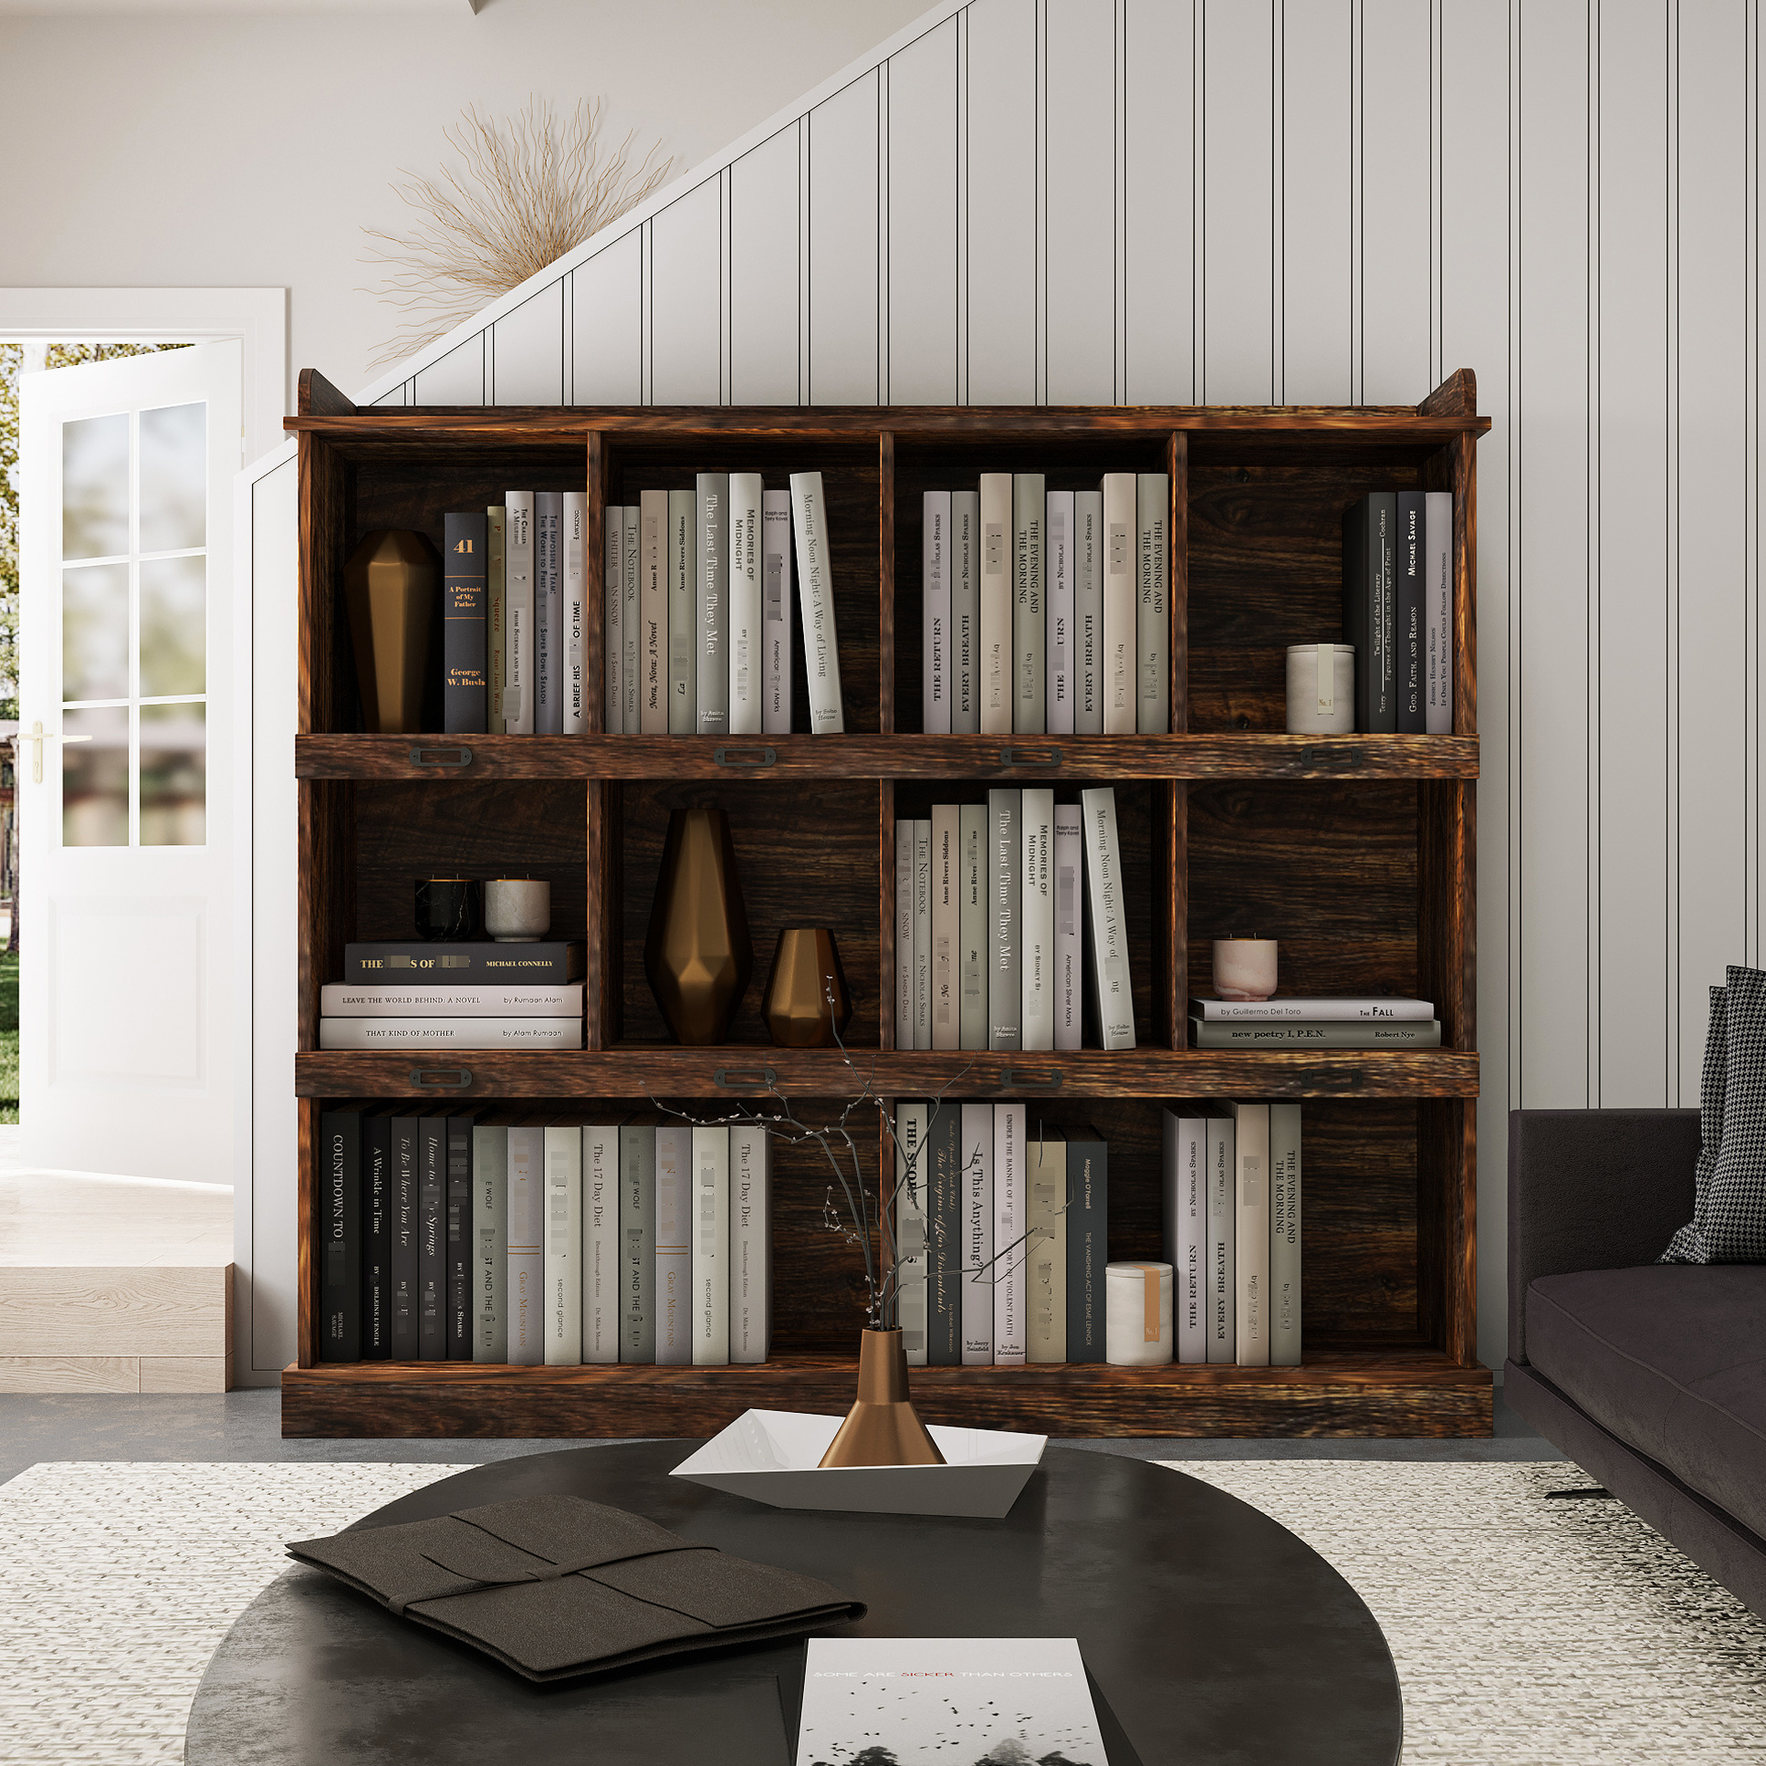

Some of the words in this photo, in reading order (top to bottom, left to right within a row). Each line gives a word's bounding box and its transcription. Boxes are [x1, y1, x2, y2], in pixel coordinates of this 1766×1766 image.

[706, 495, 717, 519] The
[803, 494, 815, 535] Morning
[678, 516, 686, 546] Siddons
[747, 510, 755, 563] MEMORIES
[1030, 520, 1038, 540] THE
[1154, 520, 1162, 540] THE
[1408, 511, 1416, 540] SAVAGE
[453, 540, 474, 553] 41
[706, 523, 717, 552] Last
[735, 520, 743, 570] MIDNIGHT
[1019, 531, 1027, 550] THE
[1143, 531, 1151, 550] THE
[678, 548, 686, 570] Rivers
[807, 539, 817, 563] Noon
[1408, 543, 1416, 576] MICHAEL
[706, 556, 717, 589] Time
[747, 567, 755, 581] OF
[1030, 544, 1038, 588] EVENING
[1154, 544, 1162, 588] EVENING
[678, 572, 686, 591] Anne
[809, 567, 821, 597] Night:
[1019, 554, 1027, 603] MORNING
[1143, 554, 1151, 603] MORNING
[705, 593, 717, 625] They
[813, 600, 822, 608] A
[1030, 591, 1038, 613] AND
[1154, 591, 1162, 613] AND
[573, 625, 580, 638] OF
[813, 610, 824, 631] Way
[648, 621, 657, 645] Novel
[706, 630, 717, 654] Met
[817, 633, 826, 643] of
[1085, 615, 1093, 666] BREATH
[648, 648, 657, 656] A
[816, 646, 828, 677] Living
[451, 668, 481, 676] George
[648, 686, 657, 709] Nora,
[1085, 670, 1093, 712] EVERY
[1000, 811, 1011, 835] The
[1096, 810, 1108, 851] Morning
[1000, 840, 1011, 867] Last
[1028, 835, 1036, 886] MIDNIGHT
[1100, 854, 1110, 879] Noon
[1000, 873, 1011, 904] Time
[1040, 883, 1047, 896] OF
[1102, 883, 1114, 913] Night:
[999, 909, 1011, 941] They
[1105, 926, 1117, 946] Way
[360, 960, 383, 969] THE
[420, 960, 435, 969] OF
[1000, 946, 1011, 971] Met
[1109, 949, 1118, 958] of
[504, 997, 512, 1005] by
[1221, 1008, 1230, 1016] by
[1373, 1007, 1393, 1016] FALL
[503, 1030, 511, 1038] by
[1254, 1032, 1284, 1040] poetry
[400, 1137, 410, 1150] To
[907, 1119, 917, 1148] THE
[400, 1154, 410, 1165] Be
[428, 1137, 437, 1167] Home
[593, 1144, 603, 1164] The
[741, 1144, 751, 1164] The
[972, 1153, 983, 1164] Is
[1288, 1151, 1296, 1171] THE
[333, 1135, 343, 1218] COUNTDOWN
[373, 1158, 382, 1195] Wrinkle
[428, 1170, 437, 1180] to
[593, 1168, 603, 1178] 17
[741, 1168, 751, 1178] 17
[1276, 1161, 1284, 1181] THE
[400, 1170, 410, 1202] Where
[592, 1183, 603, 1203] Day
[740, 1183, 751, 1203] Day
[972, 1170, 983, 1199] This
[1006, 1190, 1013, 1198] OF
[373, 1199, 382, 1208] in
[1288, 1174, 1296, 1218] EVENING
[400, 1205, 410, 1224] You
[593, 1207, 603, 1227] Diet
[741, 1207, 751, 1227] Diet
[1276, 1184, 1284, 1233] MORNING
[333, 1221, 343, 1238] TO
[373, 1210, 382, 1234] Time
[1288, 1222, 1296, 1243] AND
[400, 1230, 410, 1246] Are
[427, 1215, 437, 1256] Springs
[971, 1203, 983, 1267] Anything?
[1217, 1242, 1225, 1293] BREATH
[556, 1310, 564, 1337] glance
[1217, 1298, 1225, 1339] EVERY
